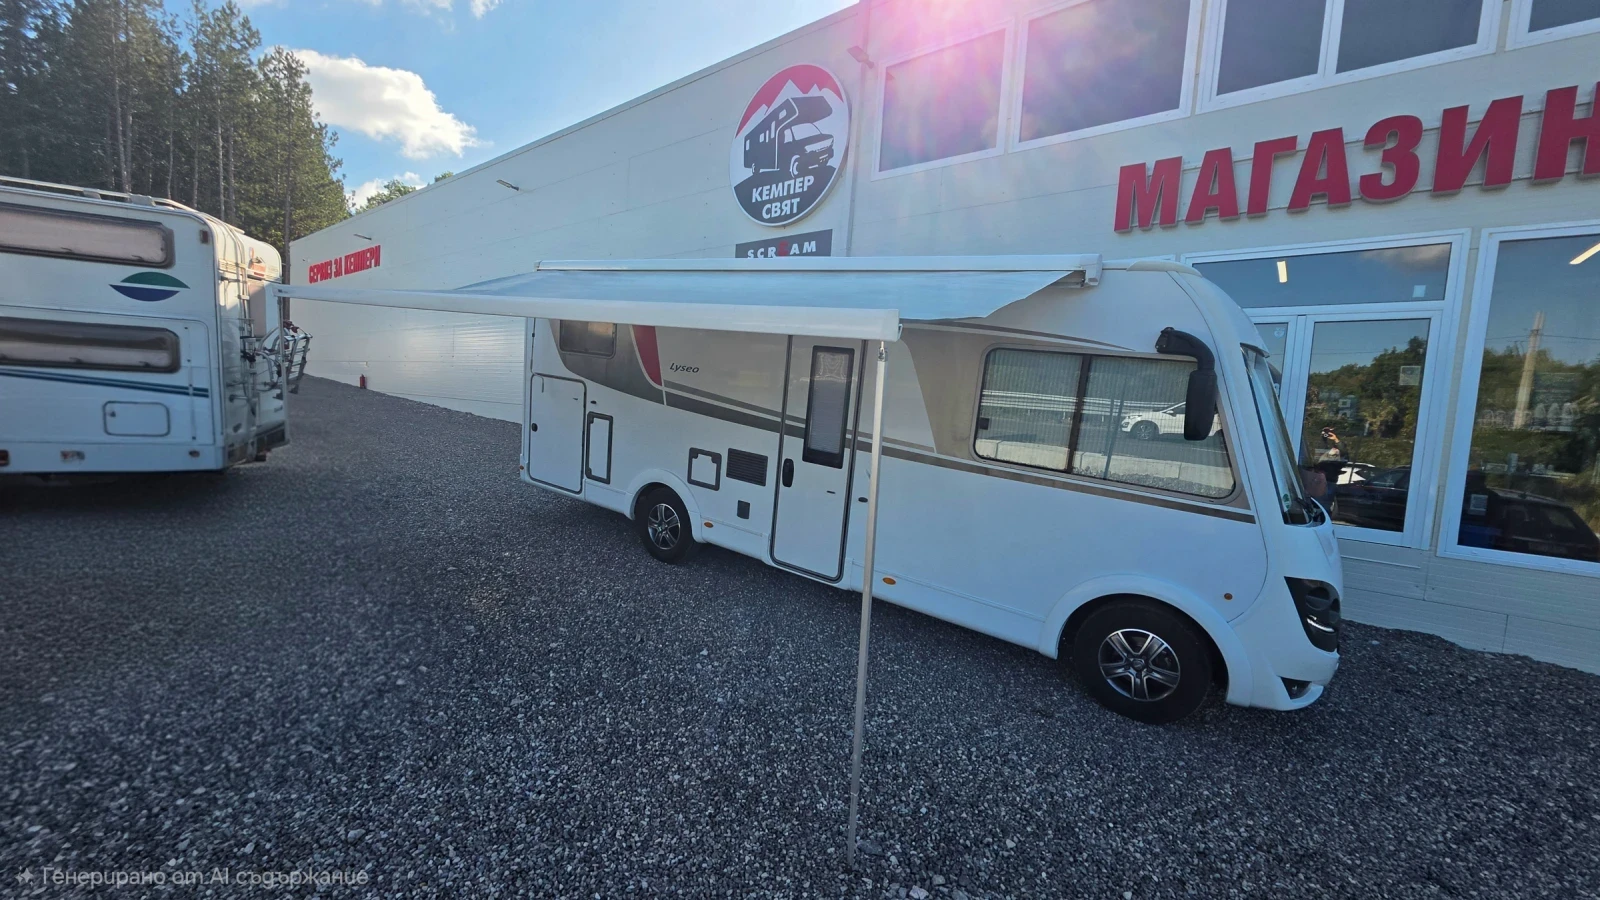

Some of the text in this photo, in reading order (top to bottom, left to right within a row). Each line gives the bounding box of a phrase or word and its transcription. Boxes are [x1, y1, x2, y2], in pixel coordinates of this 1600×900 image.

[1114, 82, 1600, 233] МАГАЗИН
[752, 175, 815, 203] КЕМПЕР
[762, 197, 801, 220] СВЯТ
[747, 240, 817, 259] SCREAM
[308, 244, 381, 284] СЕРВИЗ ЗА КЕМПЕРИ
[669, 362, 700, 374] Lyseo
